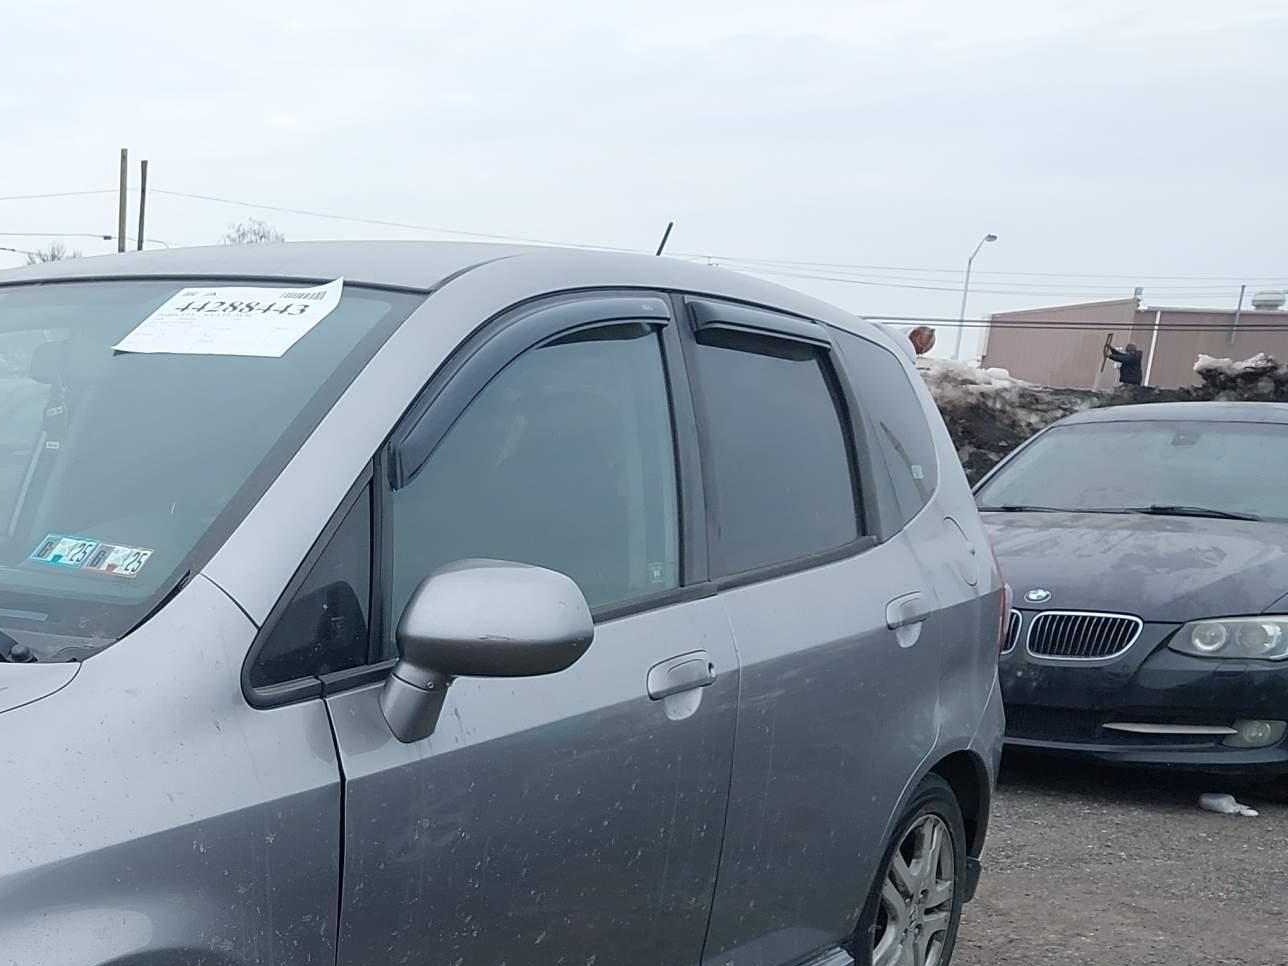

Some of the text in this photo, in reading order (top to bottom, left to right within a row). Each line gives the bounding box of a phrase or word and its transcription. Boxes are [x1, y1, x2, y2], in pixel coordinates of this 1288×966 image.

[175, 300, 311, 316] 44288443
[69, 542, 94, 563] 25
[123, 551, 148, 573] 25
